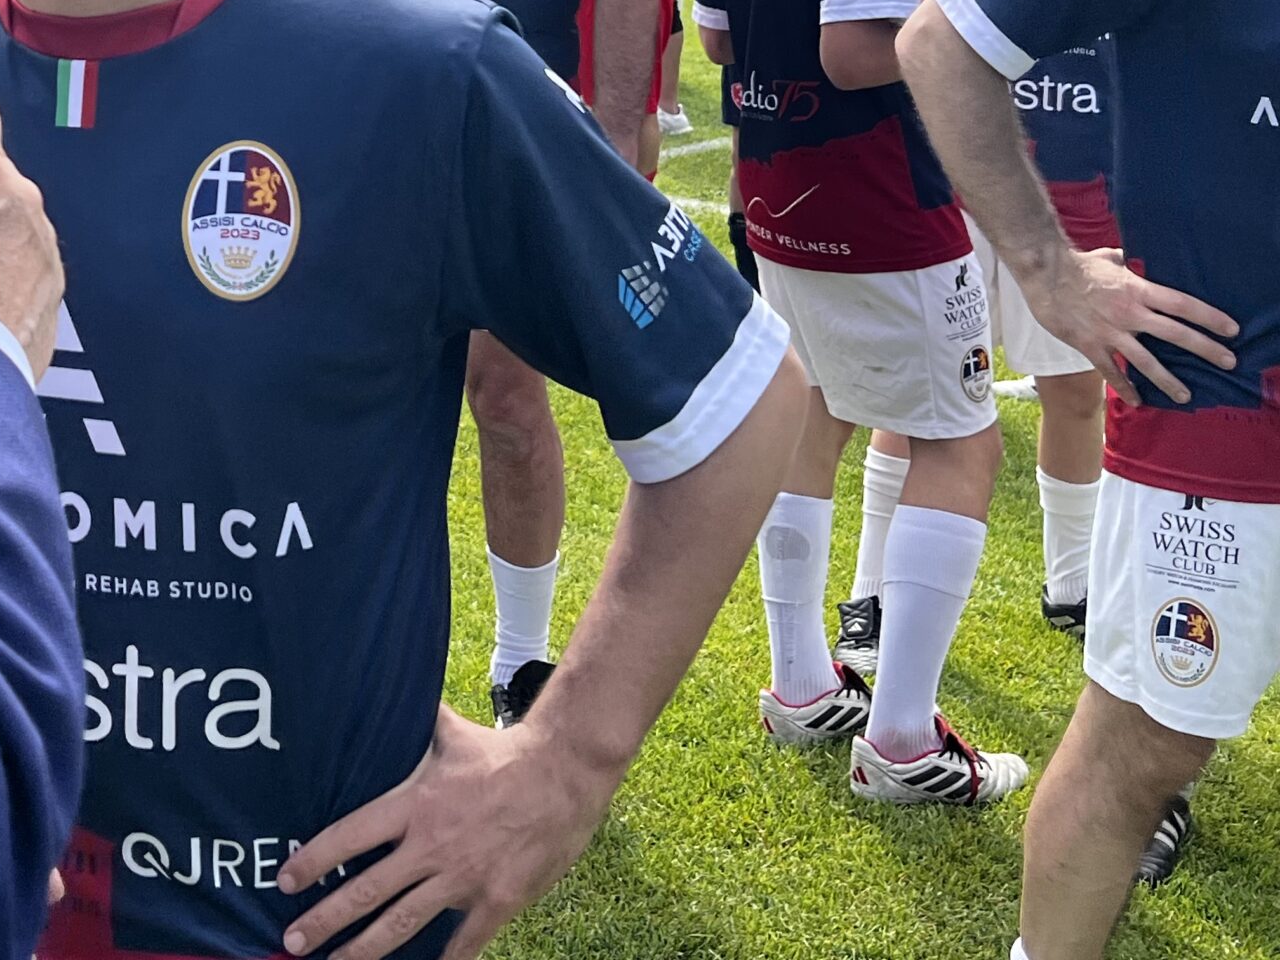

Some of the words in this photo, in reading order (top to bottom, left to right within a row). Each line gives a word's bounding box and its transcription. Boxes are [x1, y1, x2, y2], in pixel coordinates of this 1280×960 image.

[192, 216, 235, 232] ASSISI
[240, 217, 289, 236] CALCIO
[220, 228, 261, 240] 2023
[945, 285, 982, 310] SWISS
[944, 299, 986, 324] WATCH
[1160, 511, 1235, 542] SWISS
[1152, 531, 1240, 565] WATCH
[1172, 556, 1216, 575] CLUB
[85, 573, 160, 598] REHAB
[169, 580, 253, 603] STUDIO
[1171, 645, 1195, 656] 2023
[1183, 641, 1213, 657] CALCIO
